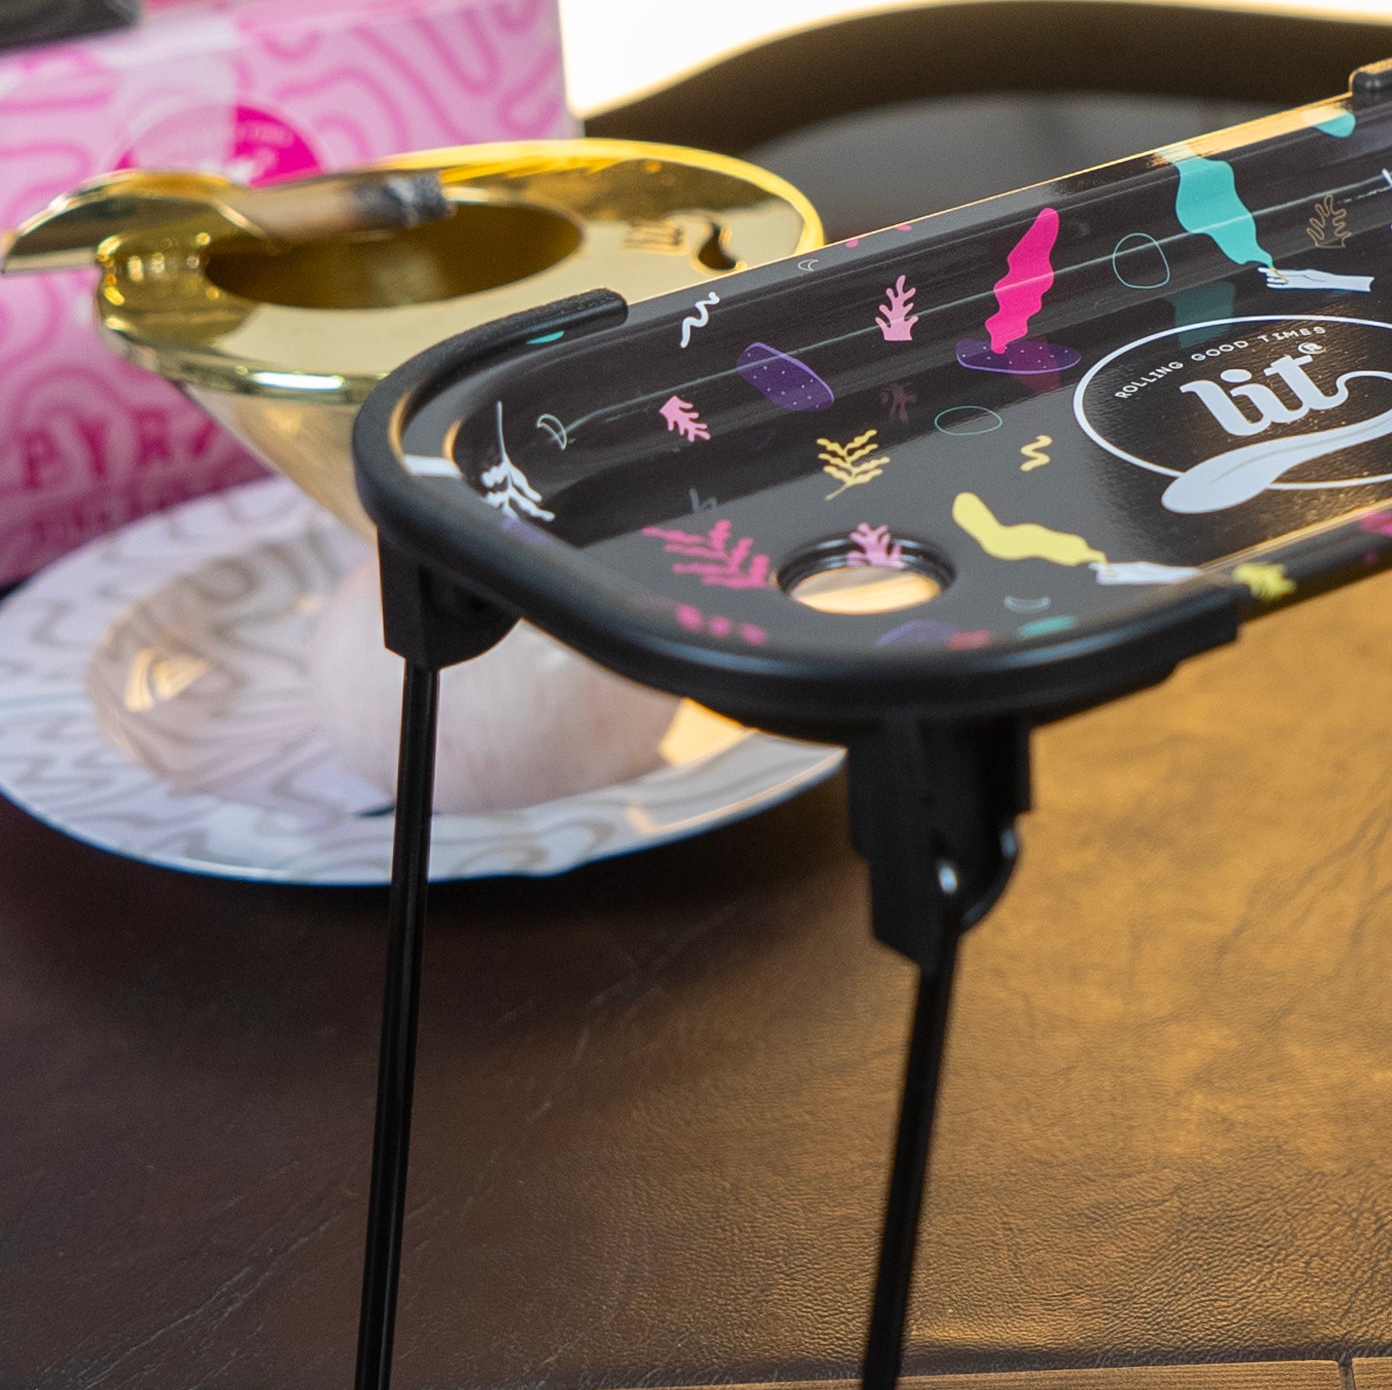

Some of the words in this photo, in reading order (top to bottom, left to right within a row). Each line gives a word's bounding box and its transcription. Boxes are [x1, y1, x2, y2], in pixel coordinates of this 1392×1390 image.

[1115, 360, 1184, 399] ROLLING
[1191, 340, 1249, 361] GOOD
[1257, 326, 1326, 343] TIMES
